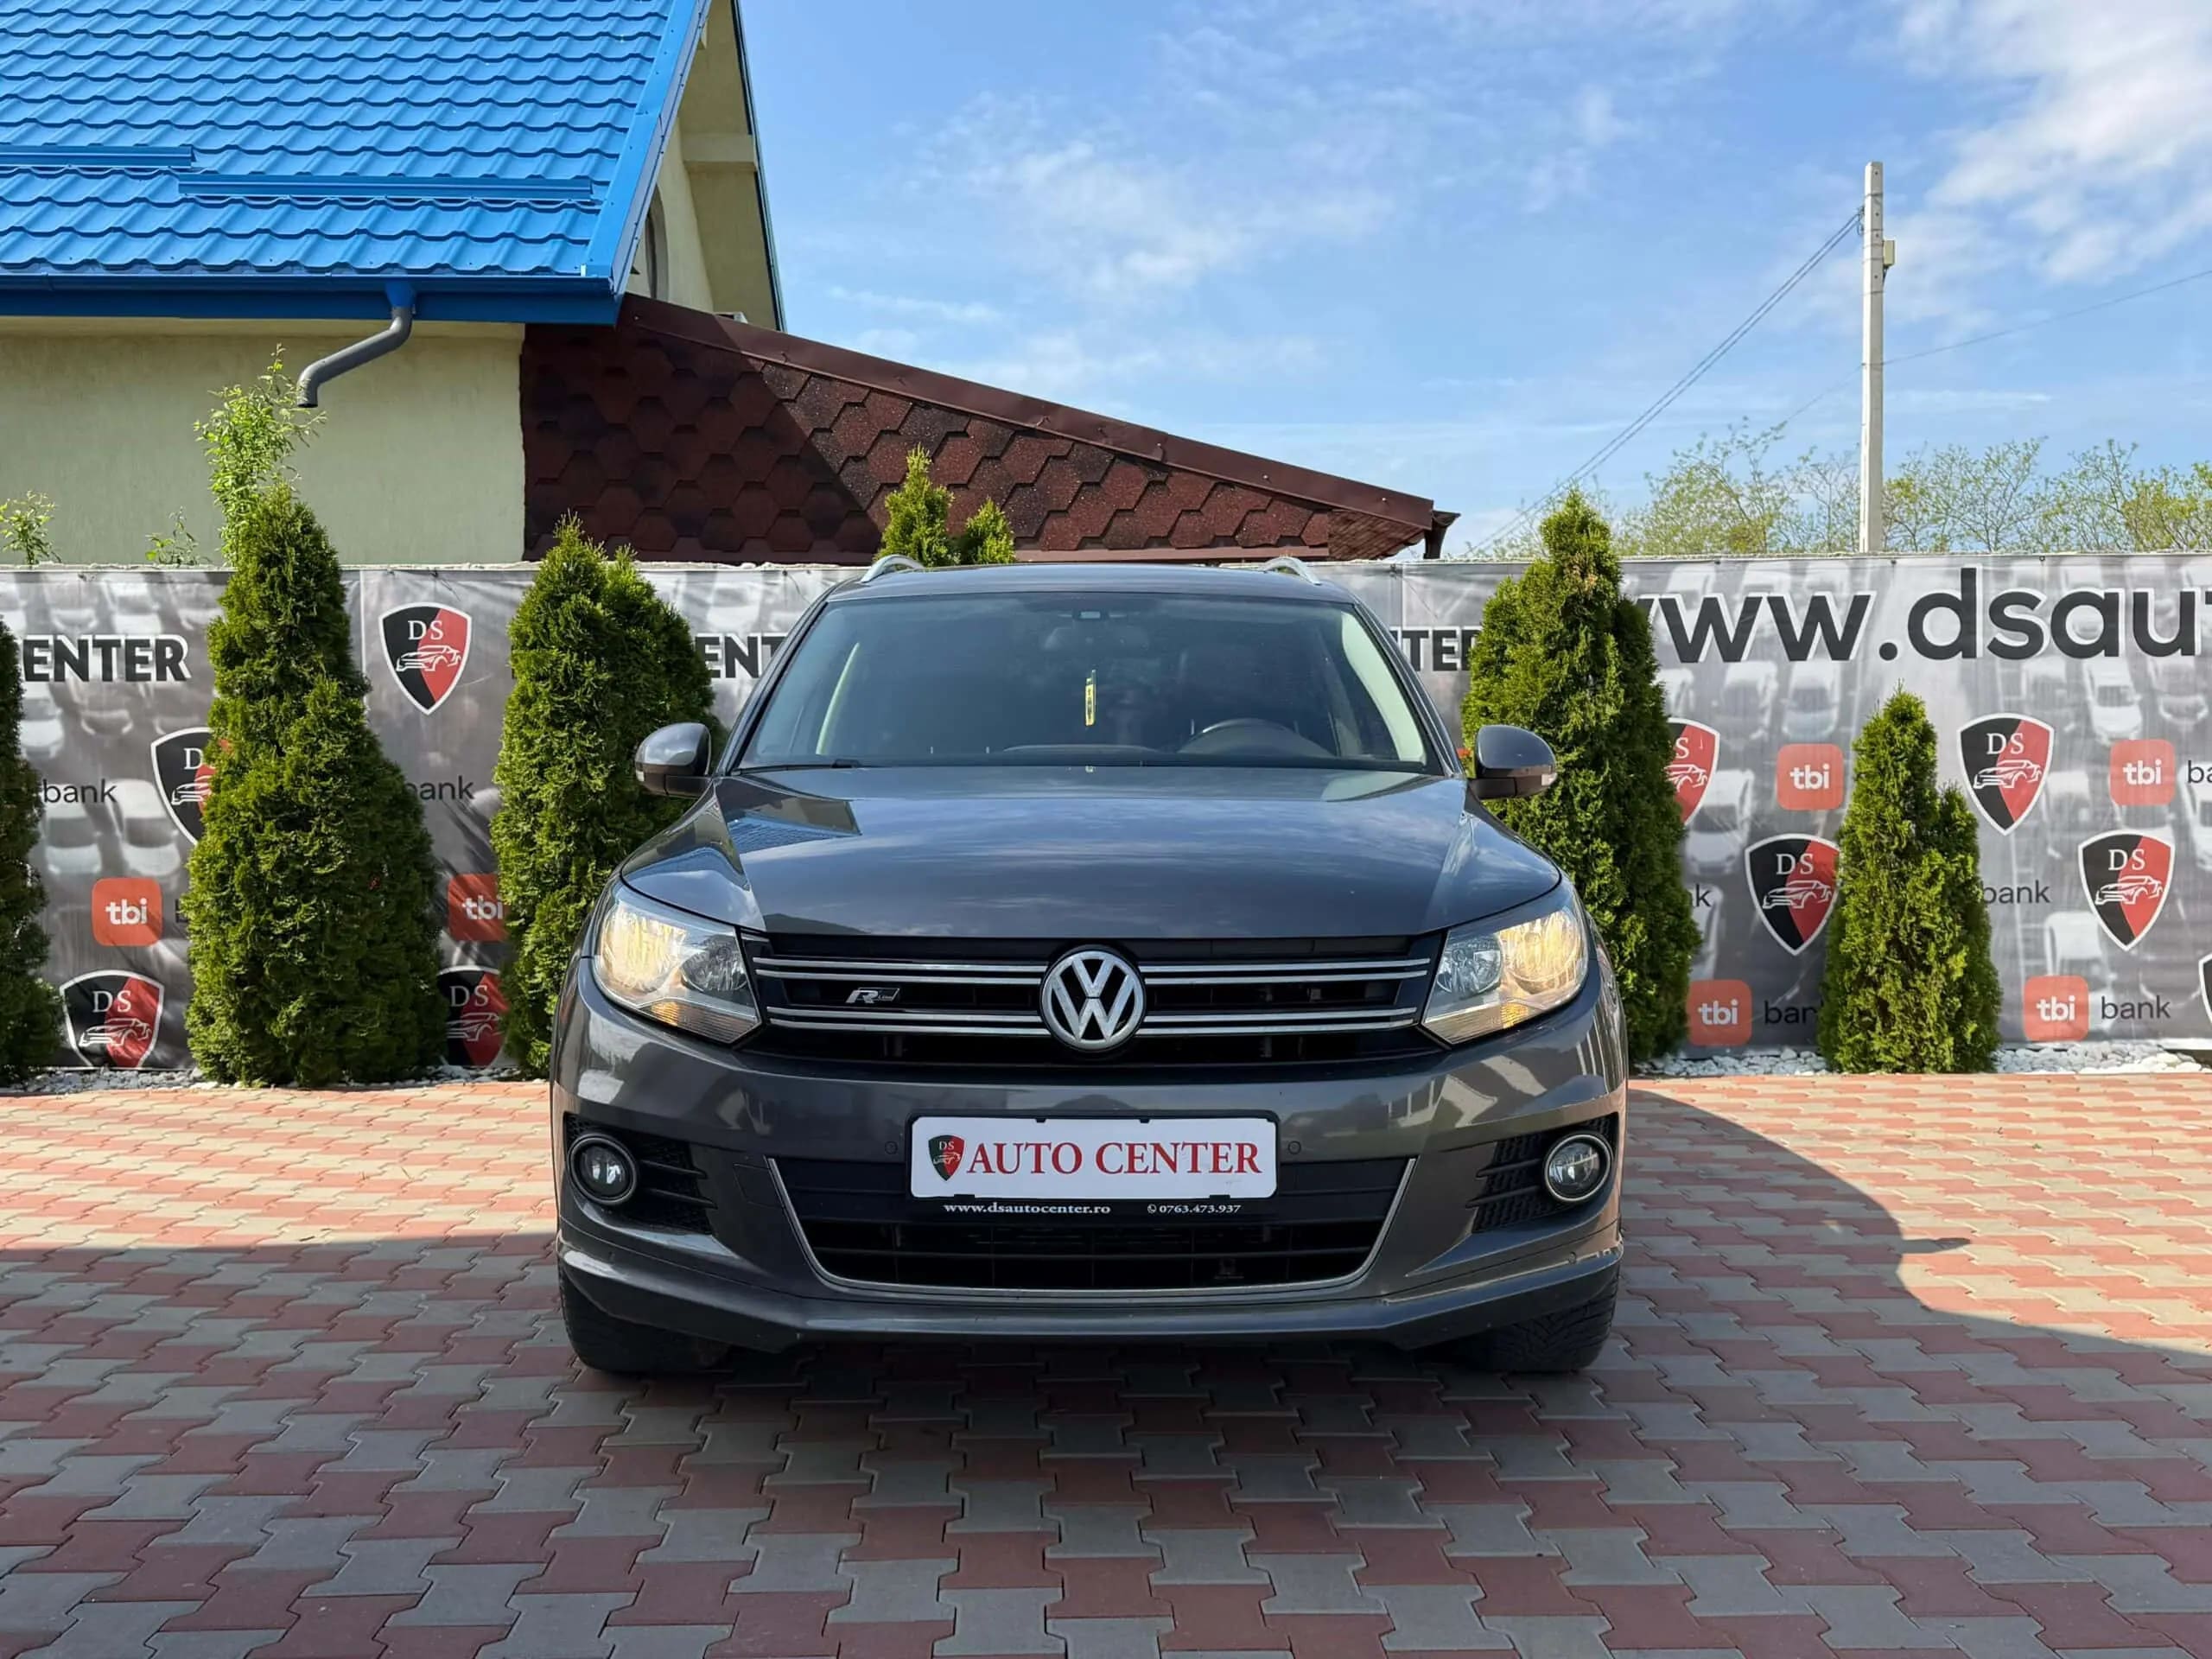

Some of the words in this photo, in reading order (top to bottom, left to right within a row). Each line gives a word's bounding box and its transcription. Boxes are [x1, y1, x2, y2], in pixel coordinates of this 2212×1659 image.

[1637, 567, 2212, 663] ww.dsau
[408, 620, 444, 640] DS
[22, 638, 187, 682] ENTER
[1986, 733, 2024, 754] DS
[1789, 764, 1830, 790] tbi
[2122, 759, 2162, 785] tbi
[43, 779, 118, 804] bank
[1777, 853, 1814, 875] DS
[2108, 849, 2145, 871] DS
[105, 897, 148, 925] tbi
[462, 895, 504, 920] tbi
[92, 990, 132, 1013] DS
[449, 985, 489, 1007] DS
[2036, 995, 2076, 1021] tbi
[2101, 995, 2171, 1020] bank
[1698, 999, 1738, 1025] tbi
[938, 1141, 955, 1151] DS
[966, 1141, 1083, 1175] AUTO
[1095, 1141, 1262, 1175] CENTER
[943, 1201, 1111, 1214] www.dsautocenter.ro
[1159, 1204, 1242, 1214] 0763.473.937
